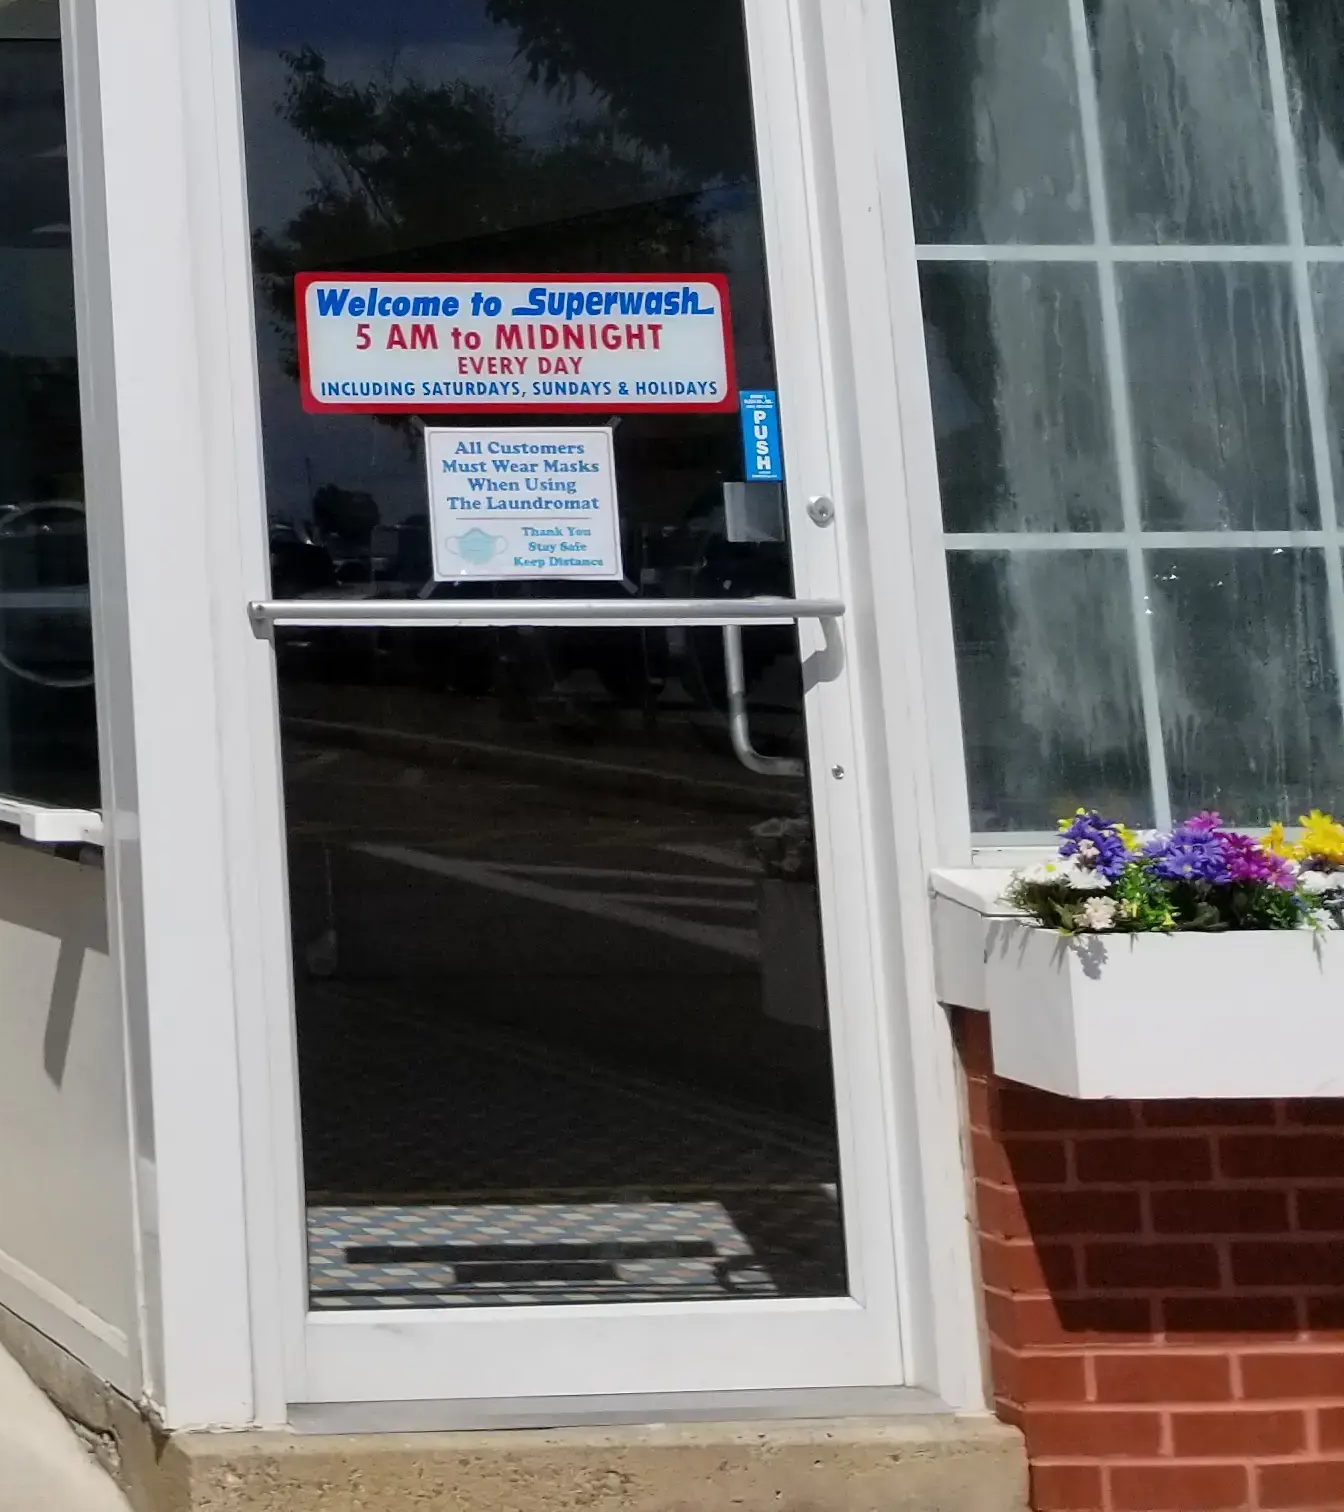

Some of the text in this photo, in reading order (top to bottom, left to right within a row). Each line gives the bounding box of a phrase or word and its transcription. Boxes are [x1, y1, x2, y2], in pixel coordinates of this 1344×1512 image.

[316, 286, 715, 320] Welcome to Superwash
[356, 323, 663, 350] 5 AM to MIDNIGHT
[458, 356, 583, 375] EVERY DAY
[321, 381, 718, 398] INCLUDING SATURDAYS, SUNDAYS & HOLIDAYS
[455, 441, 585, 454] All Customers
[753, 410, 772, 470] PUSH
[442, 459, 600, 473] Must Wear Masks
[468, 478, 577, 494] When Using
[447, 497, 600, 509] The Laundromat
[522, 527, 591, 536] Thank You
[528, 542, 587, 552] Stay Safe
[513, 557, 604, 567] Keep Distance
